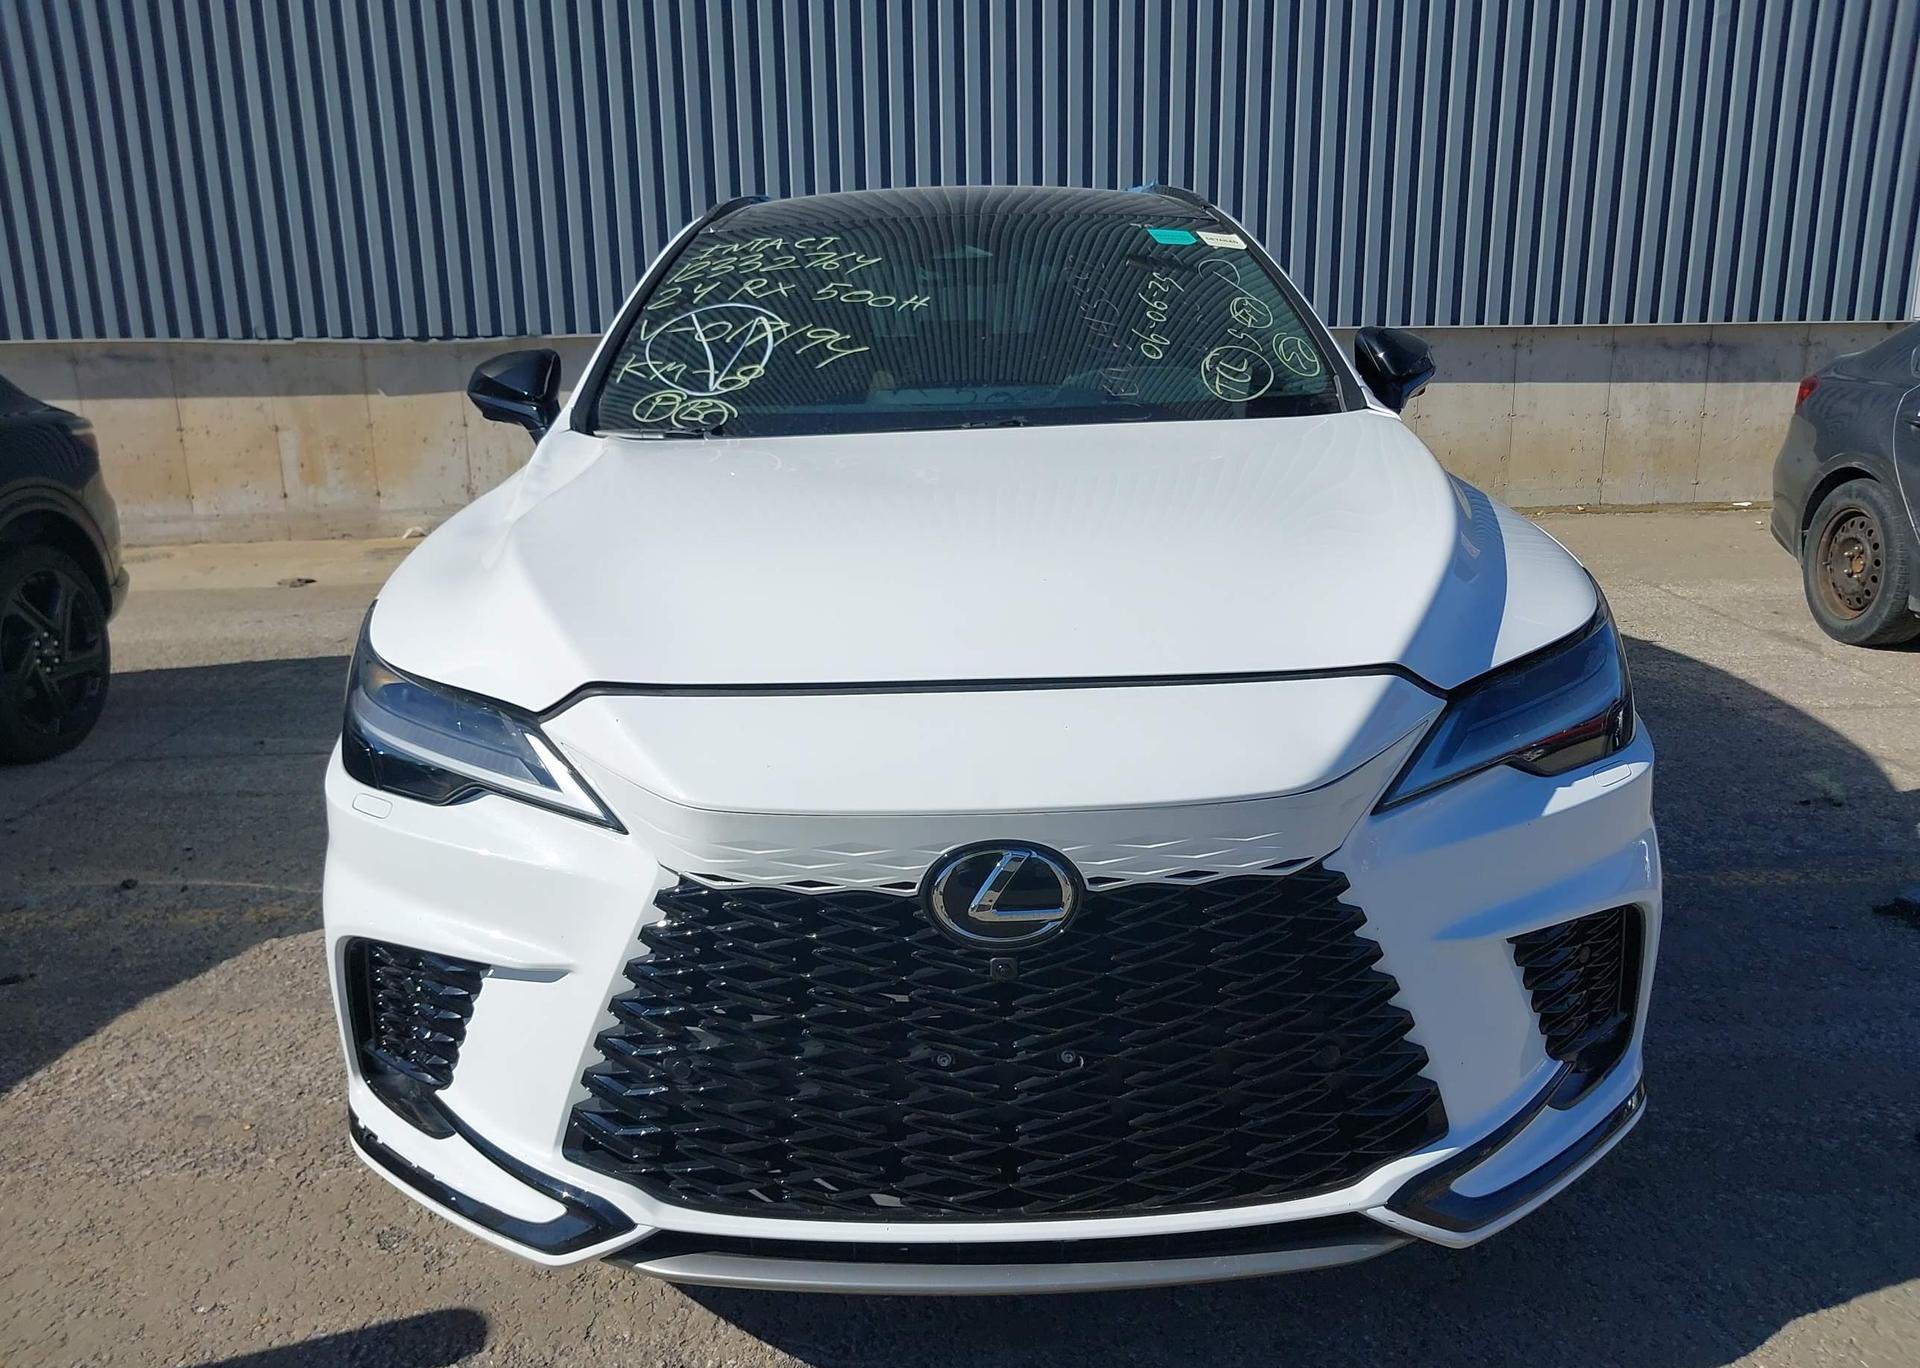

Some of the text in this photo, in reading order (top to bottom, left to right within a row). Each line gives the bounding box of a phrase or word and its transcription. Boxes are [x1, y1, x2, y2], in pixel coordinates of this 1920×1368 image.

[694, 237, 841, 260] INTACT
[647, 281, 721, 311] 24
[728, 279, 797, 301] RX
